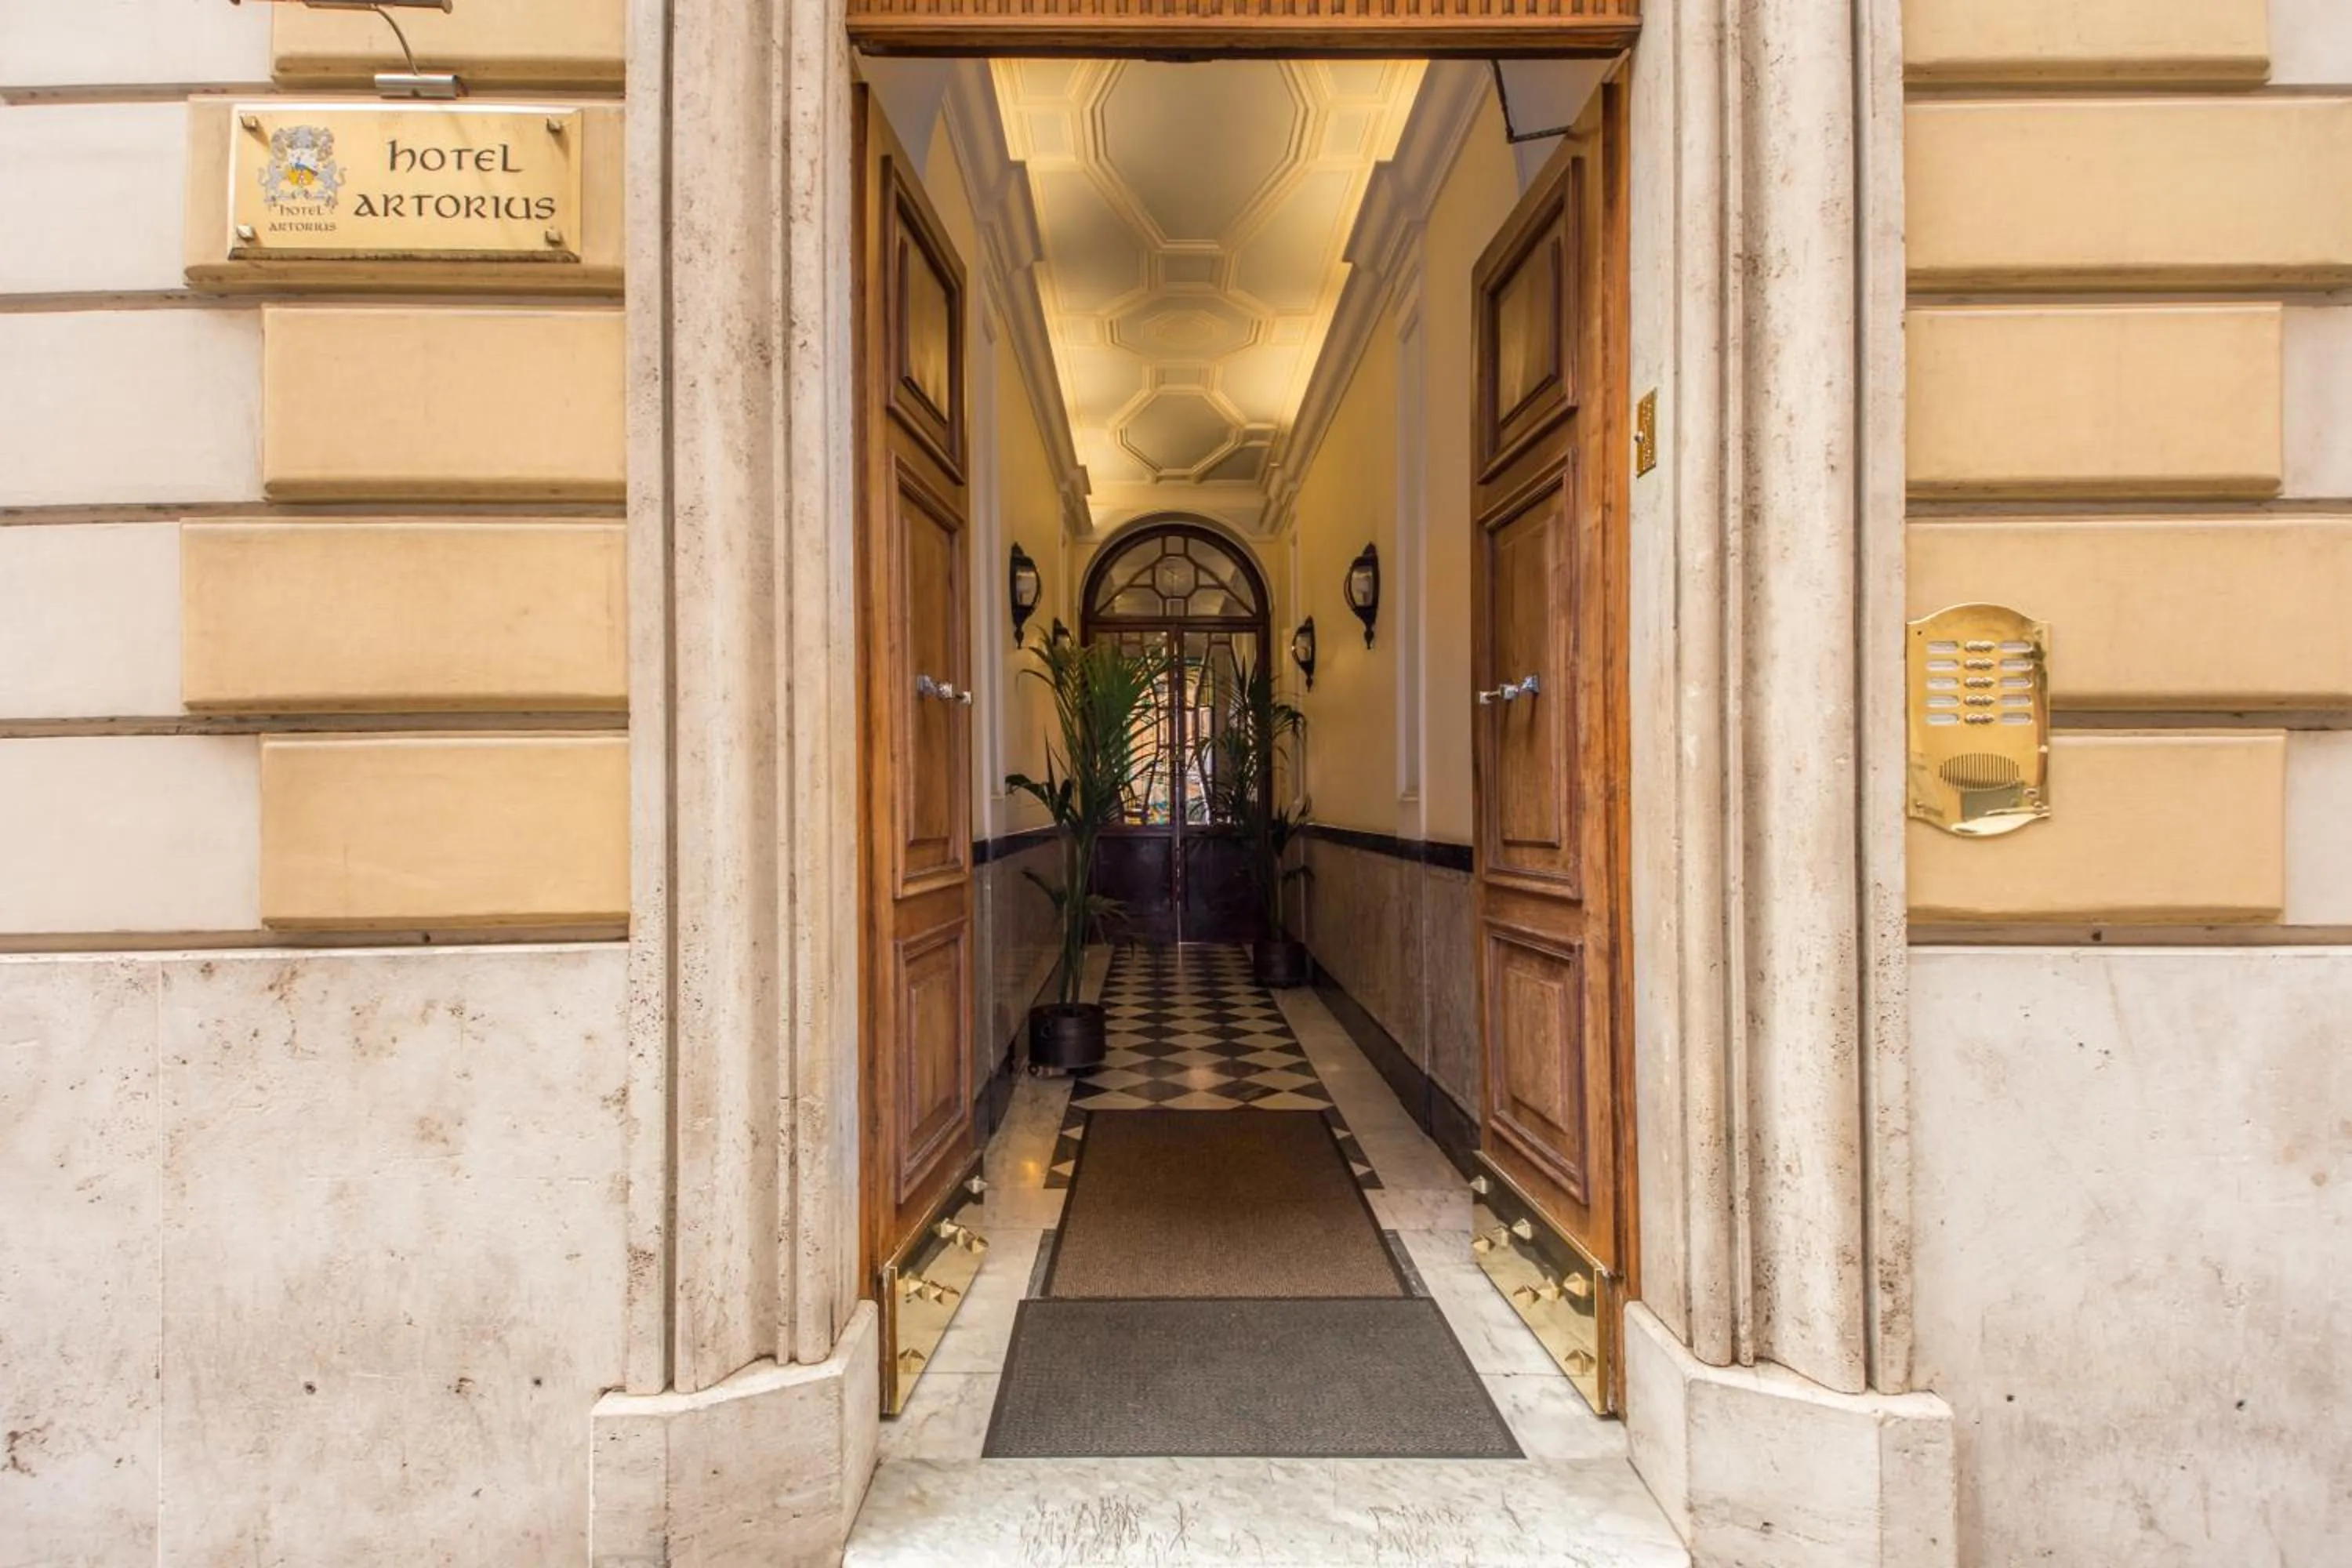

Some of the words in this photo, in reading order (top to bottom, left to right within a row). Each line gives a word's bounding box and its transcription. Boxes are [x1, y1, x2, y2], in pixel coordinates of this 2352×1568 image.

[388, 140, 523, 173] HOTEL
[353, 194, 557, 220] ARTORIUS
[268, 221, 337, 232] ARTORIUS
